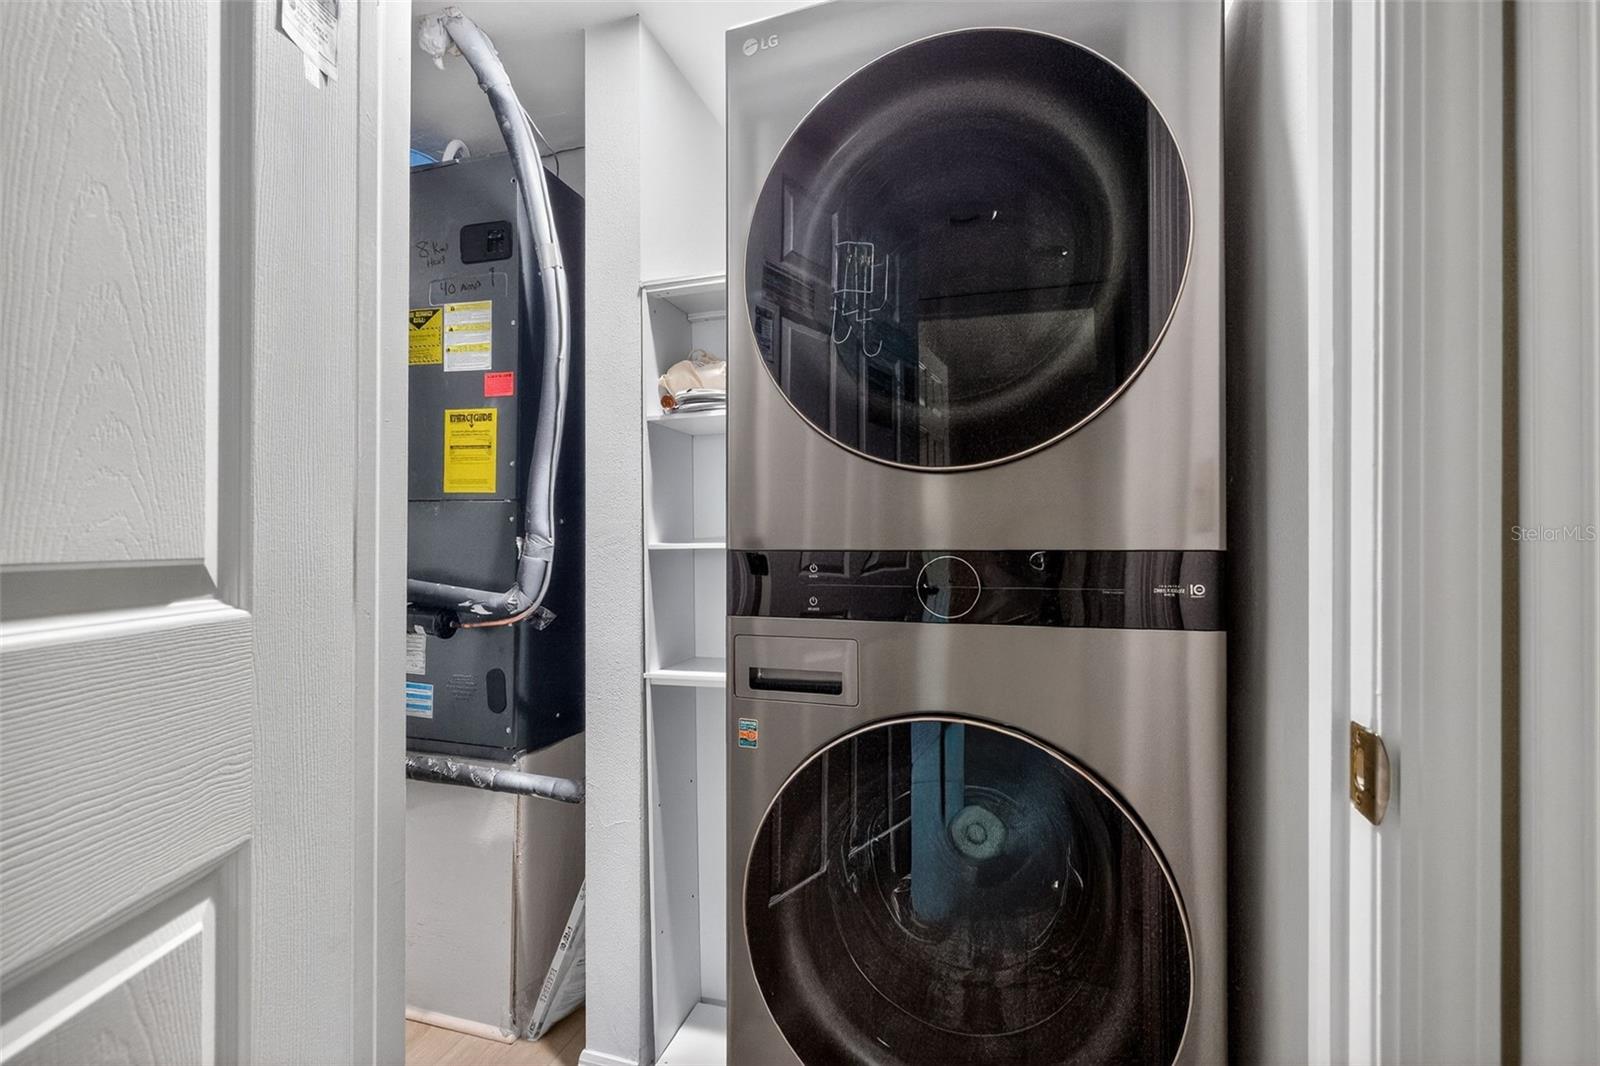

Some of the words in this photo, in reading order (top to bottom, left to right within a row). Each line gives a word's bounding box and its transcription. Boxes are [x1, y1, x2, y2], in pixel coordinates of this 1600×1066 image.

[760, 34, 778, 49] LG
[415, 240, 430, 258] 8
[440, 281, 457, 296] 40
